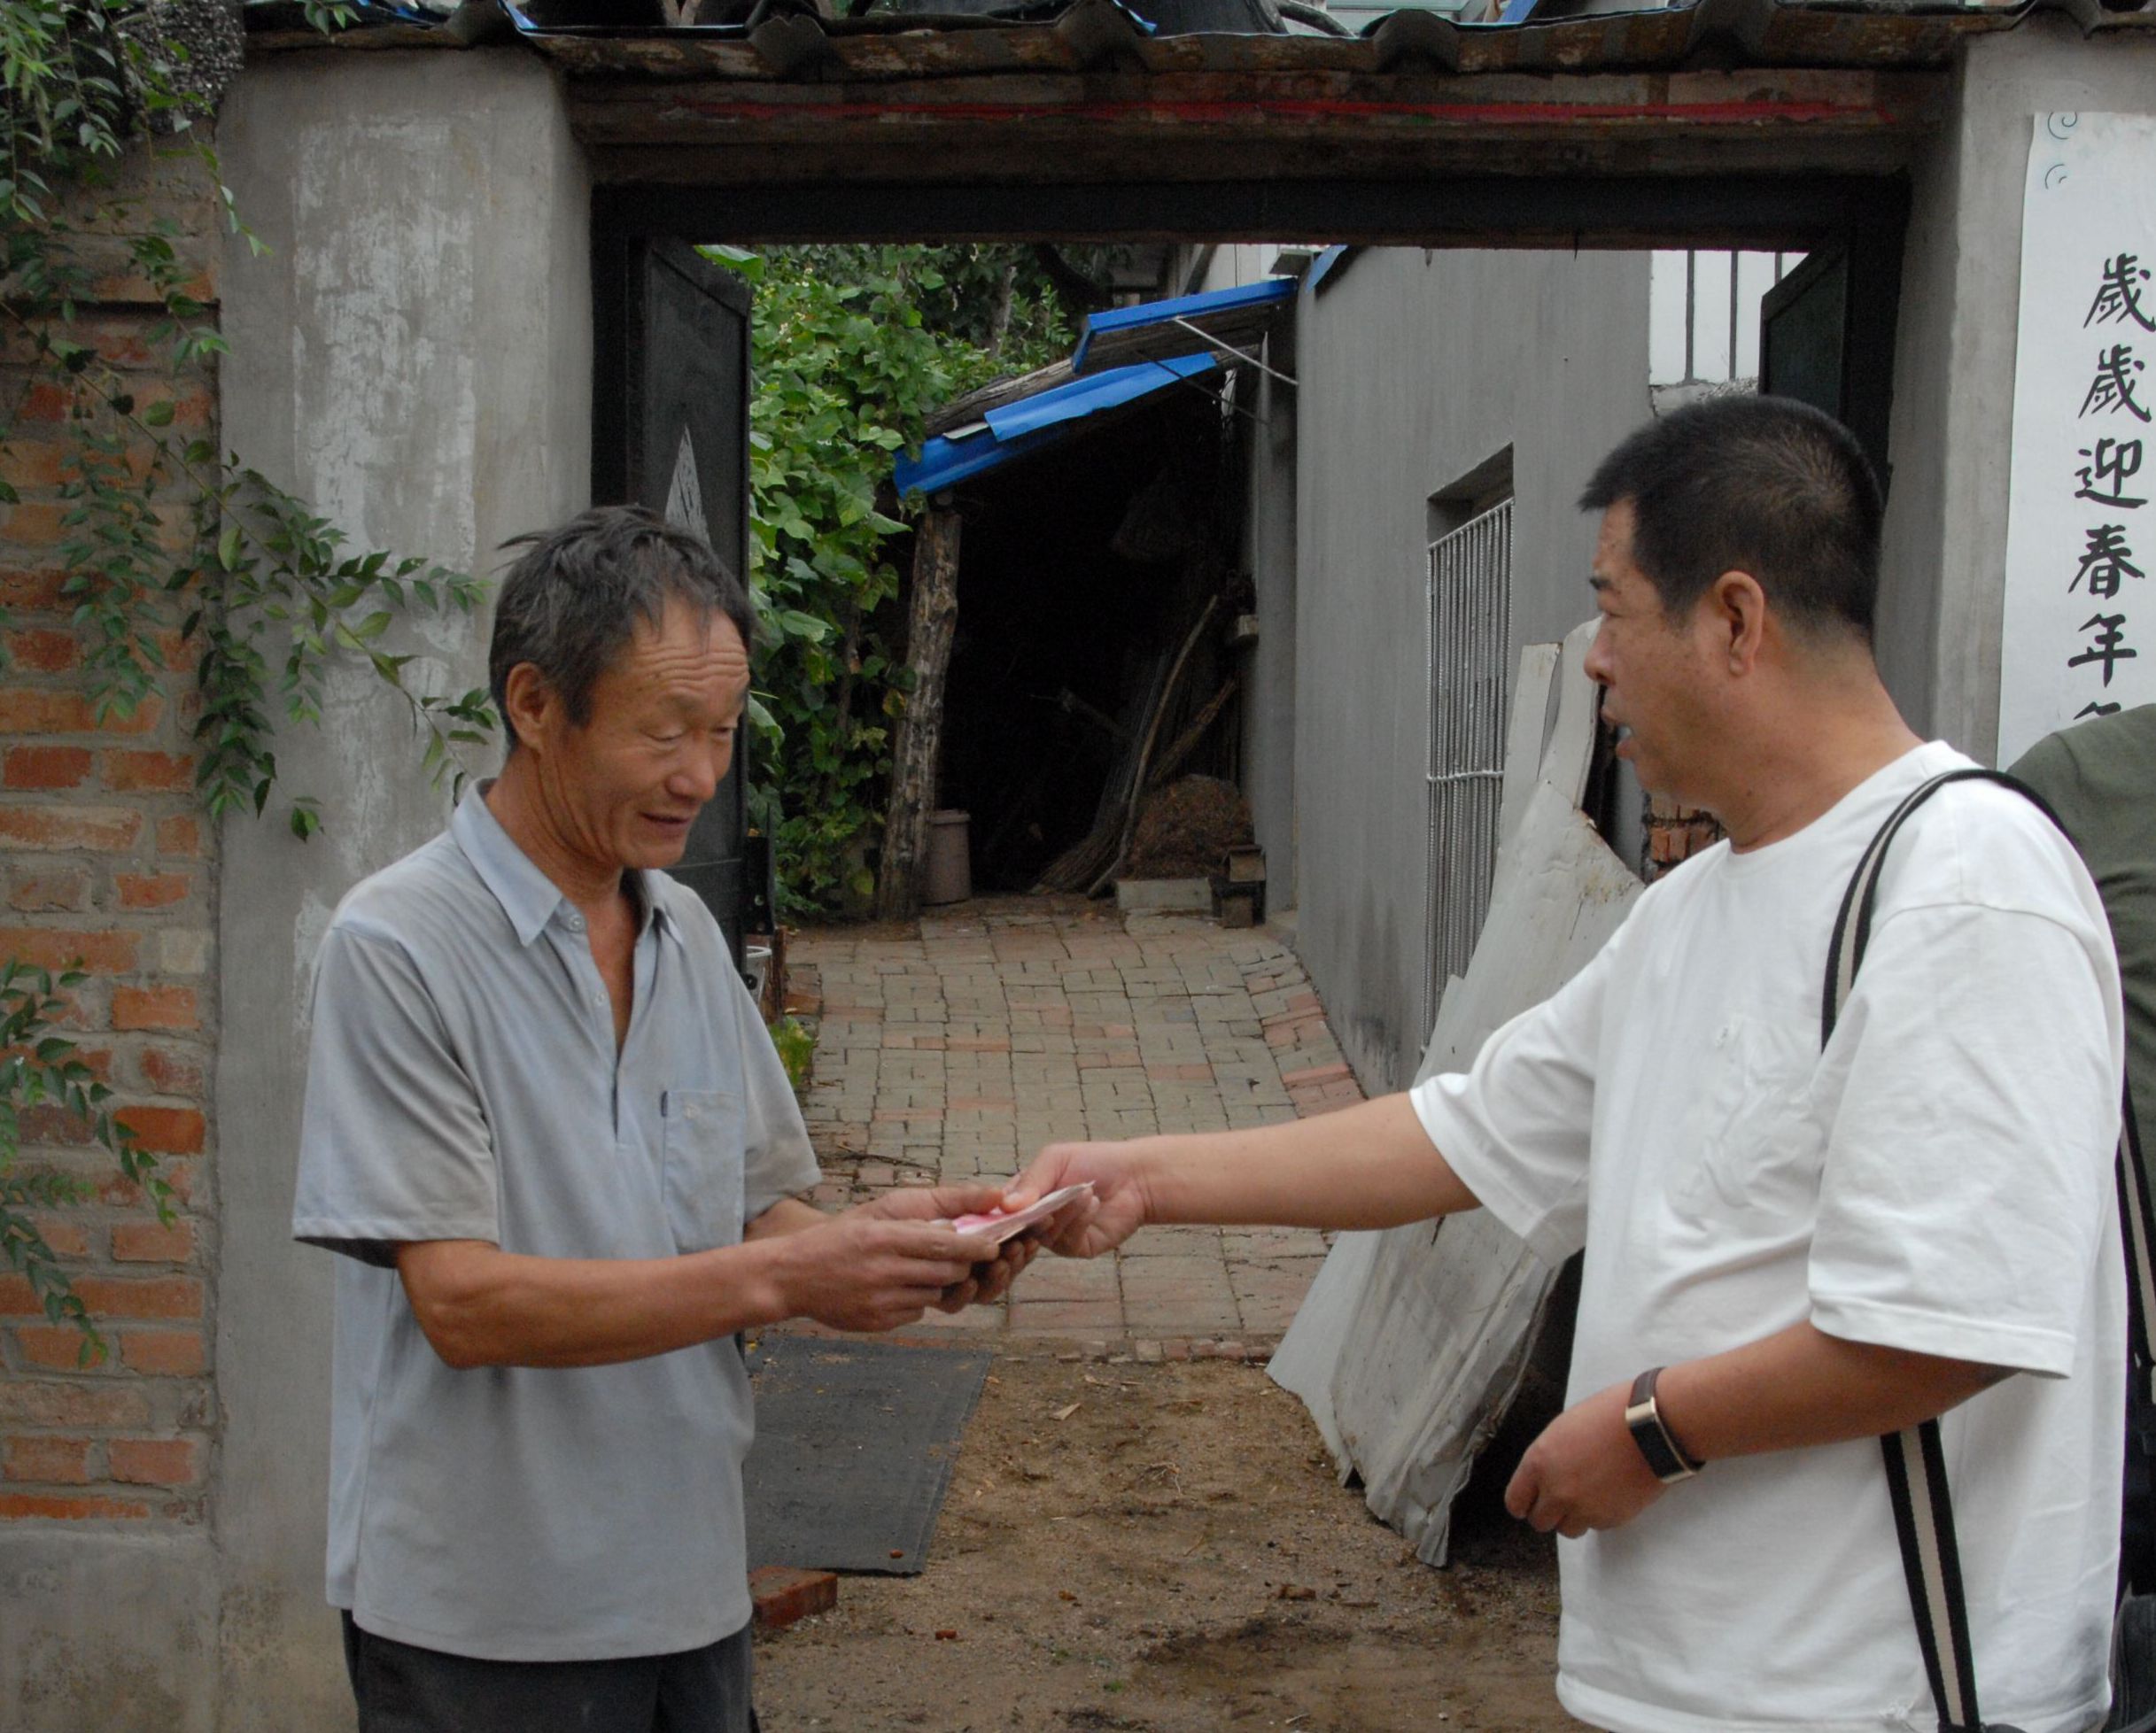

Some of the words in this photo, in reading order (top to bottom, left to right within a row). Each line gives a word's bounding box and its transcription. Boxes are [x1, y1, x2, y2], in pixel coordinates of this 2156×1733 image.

[2067, 253, 2156, 721] 歲歲迎春年
